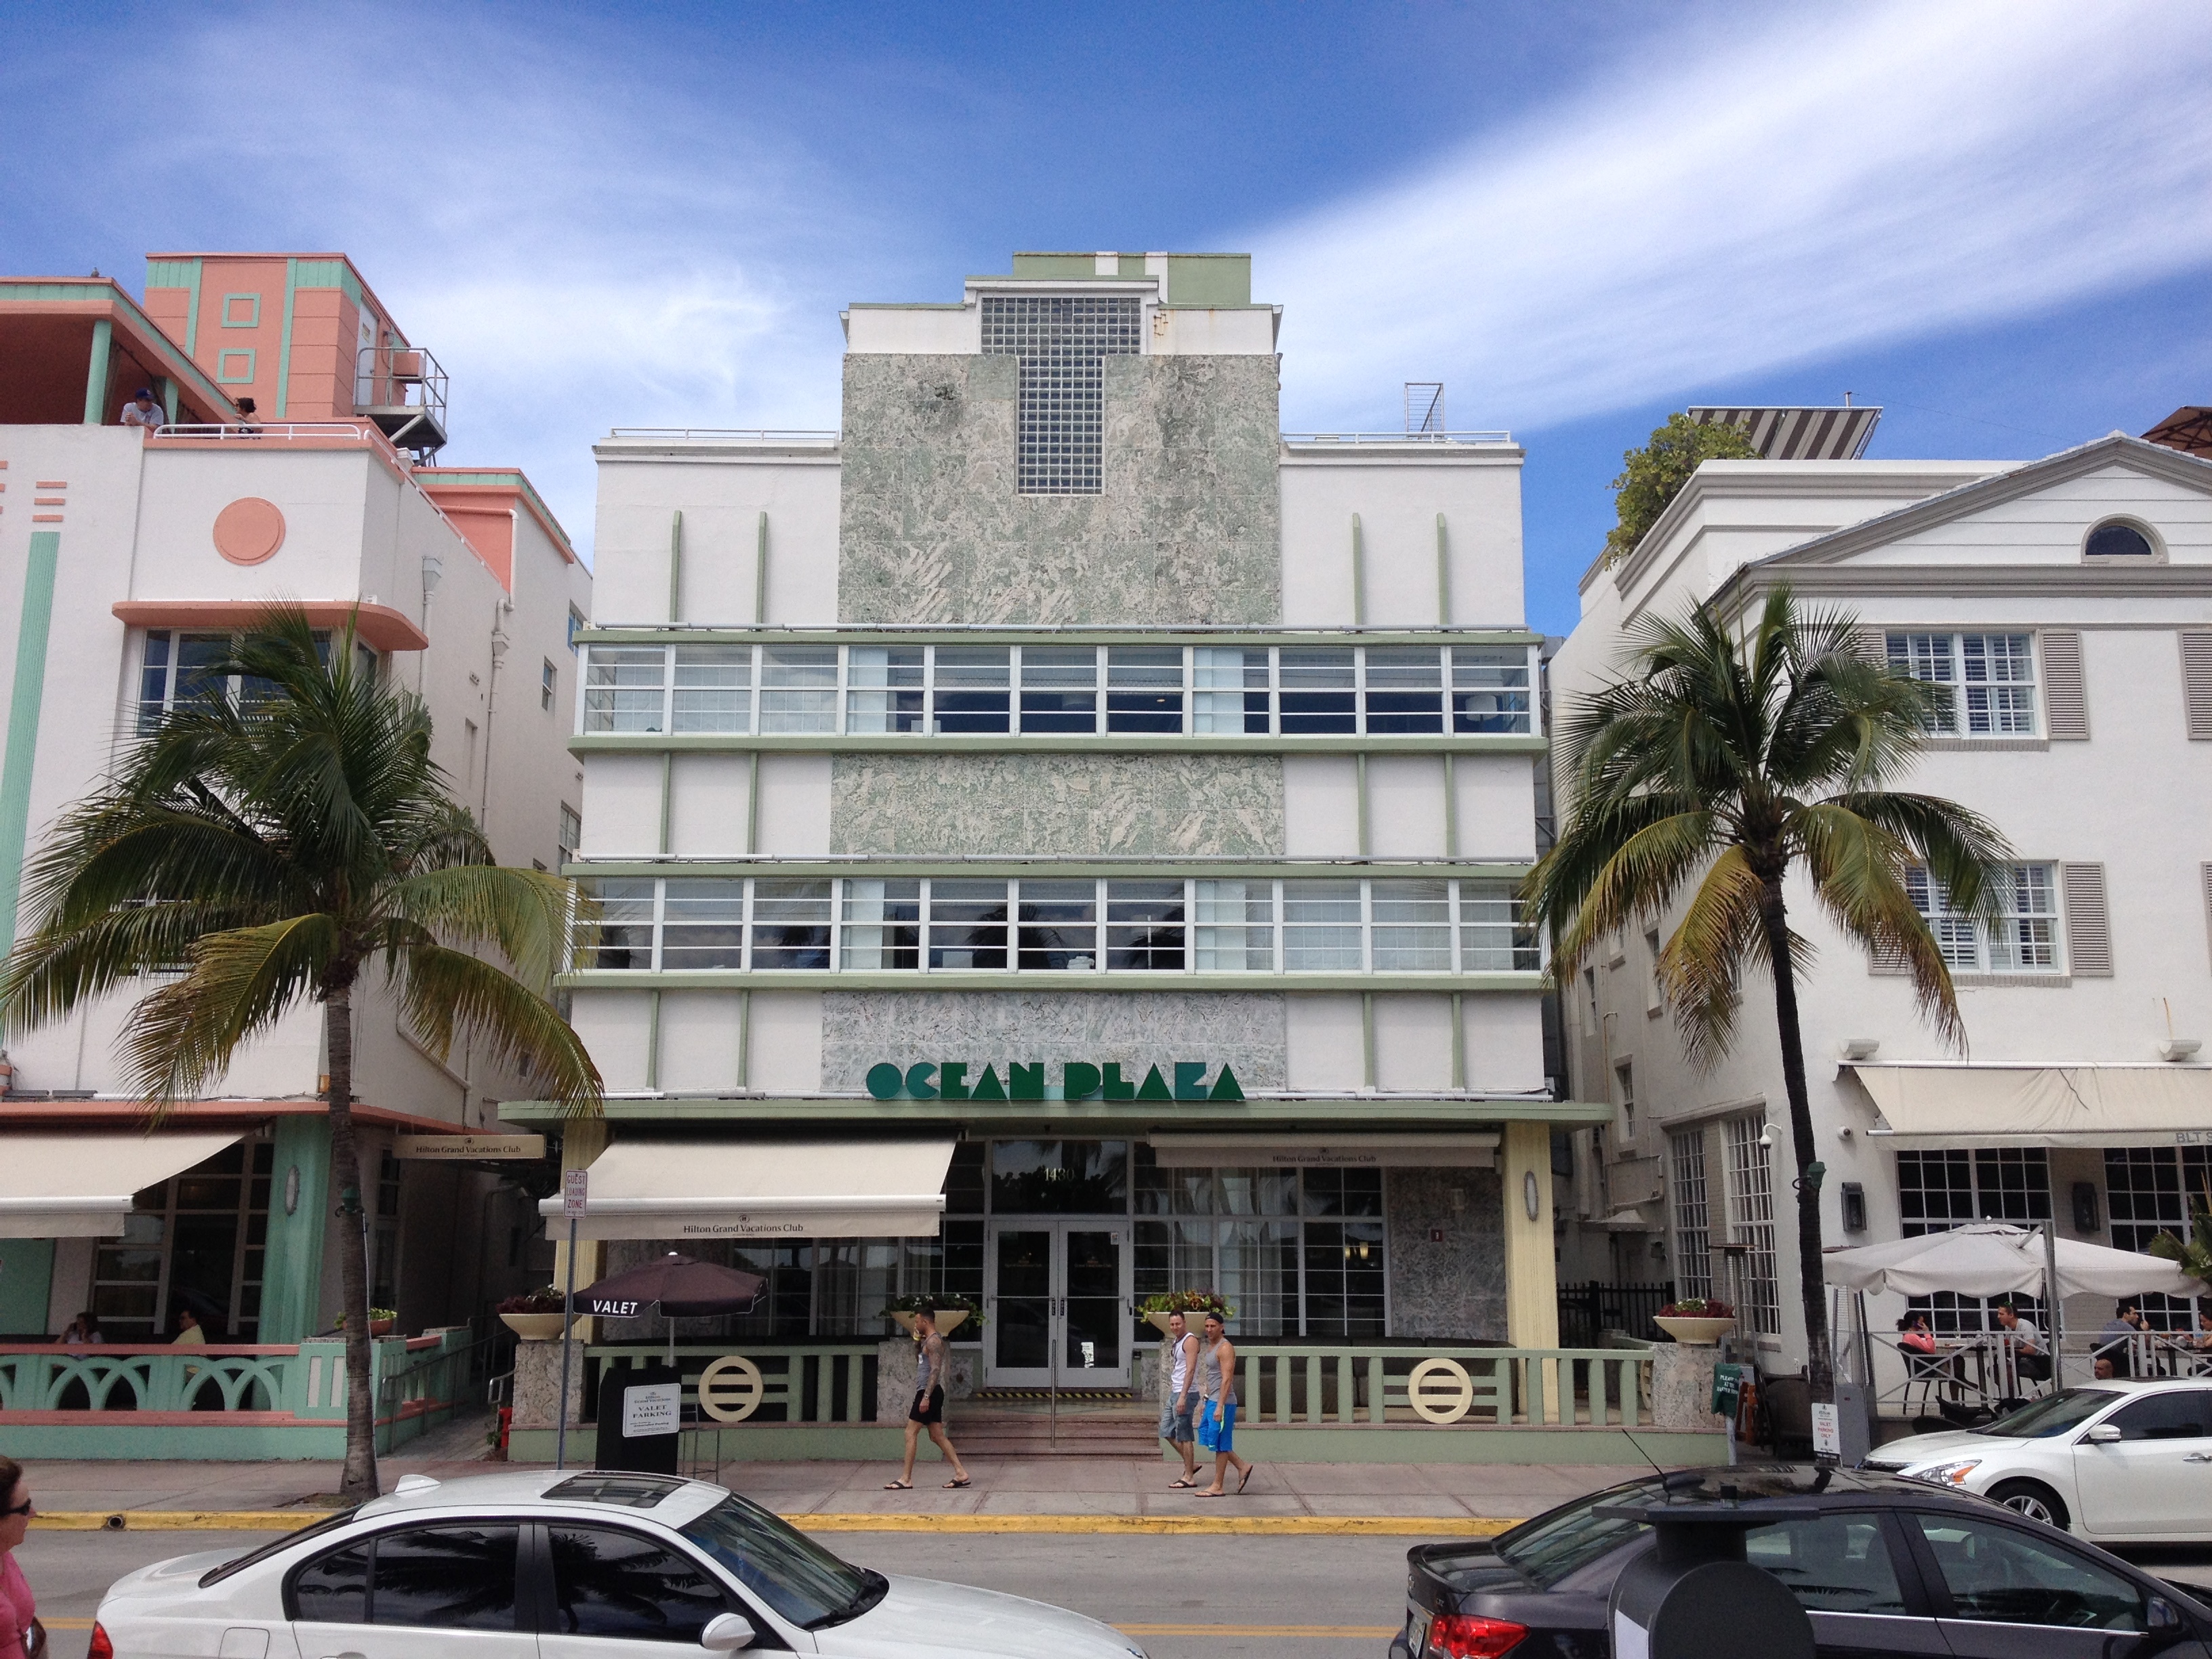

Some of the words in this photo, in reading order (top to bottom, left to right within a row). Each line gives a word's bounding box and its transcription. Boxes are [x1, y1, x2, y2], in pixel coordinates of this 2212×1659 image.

[866, 1062, 1044, 1101] OCEAN
[1064, 1062, 1246, 1101] PLAZA
[2175, 1132, 2201, 1143] BLT
[567, 1174, 585, 1185] GUEST
[1044, 1168, 1074, 1181] 1430
[568, 1199, 582, 1208] ZONE
[712, 1225, 739, 1233] Grand
[741, 1224, 781, 1232] Vacations
[783, 1224, 803, 1232] Club
[592, 1300, 638, 1315] VALET
